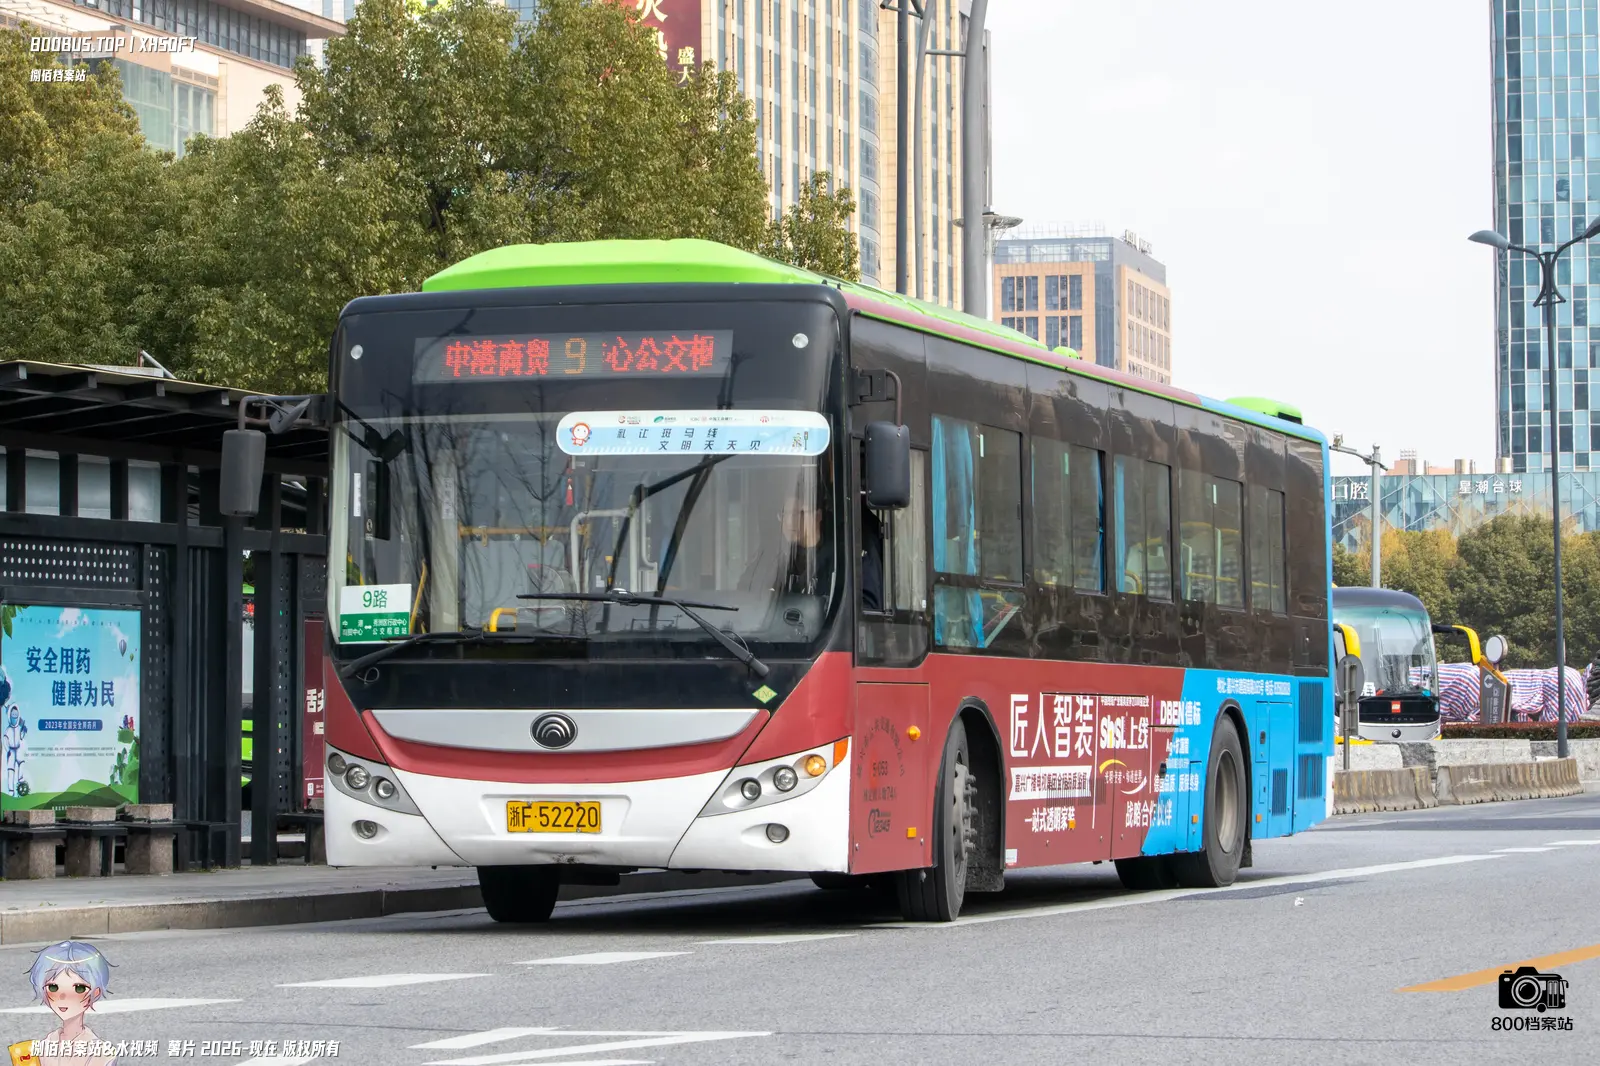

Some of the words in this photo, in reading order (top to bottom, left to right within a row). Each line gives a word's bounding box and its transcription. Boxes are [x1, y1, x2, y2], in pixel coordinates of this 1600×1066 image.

[563, 338, 587, 374] 9
[658, 440, 761, 451] 文明天天见
[1332, 482, 1369, 500] 口腔
[1459, 480, 1523, 494] 星潮台球
[362, 589, 388, 609] 9路
[26, 646, 92, 675] 安全用药
[52, 680, 116, 708] 健康为民
[44, 721, 97, 730] 2023年全国安全用药月
[1010, 693, 1093, 758] 匠人智装
[1125, 798, 1173, 828] 战略合作伙伴
